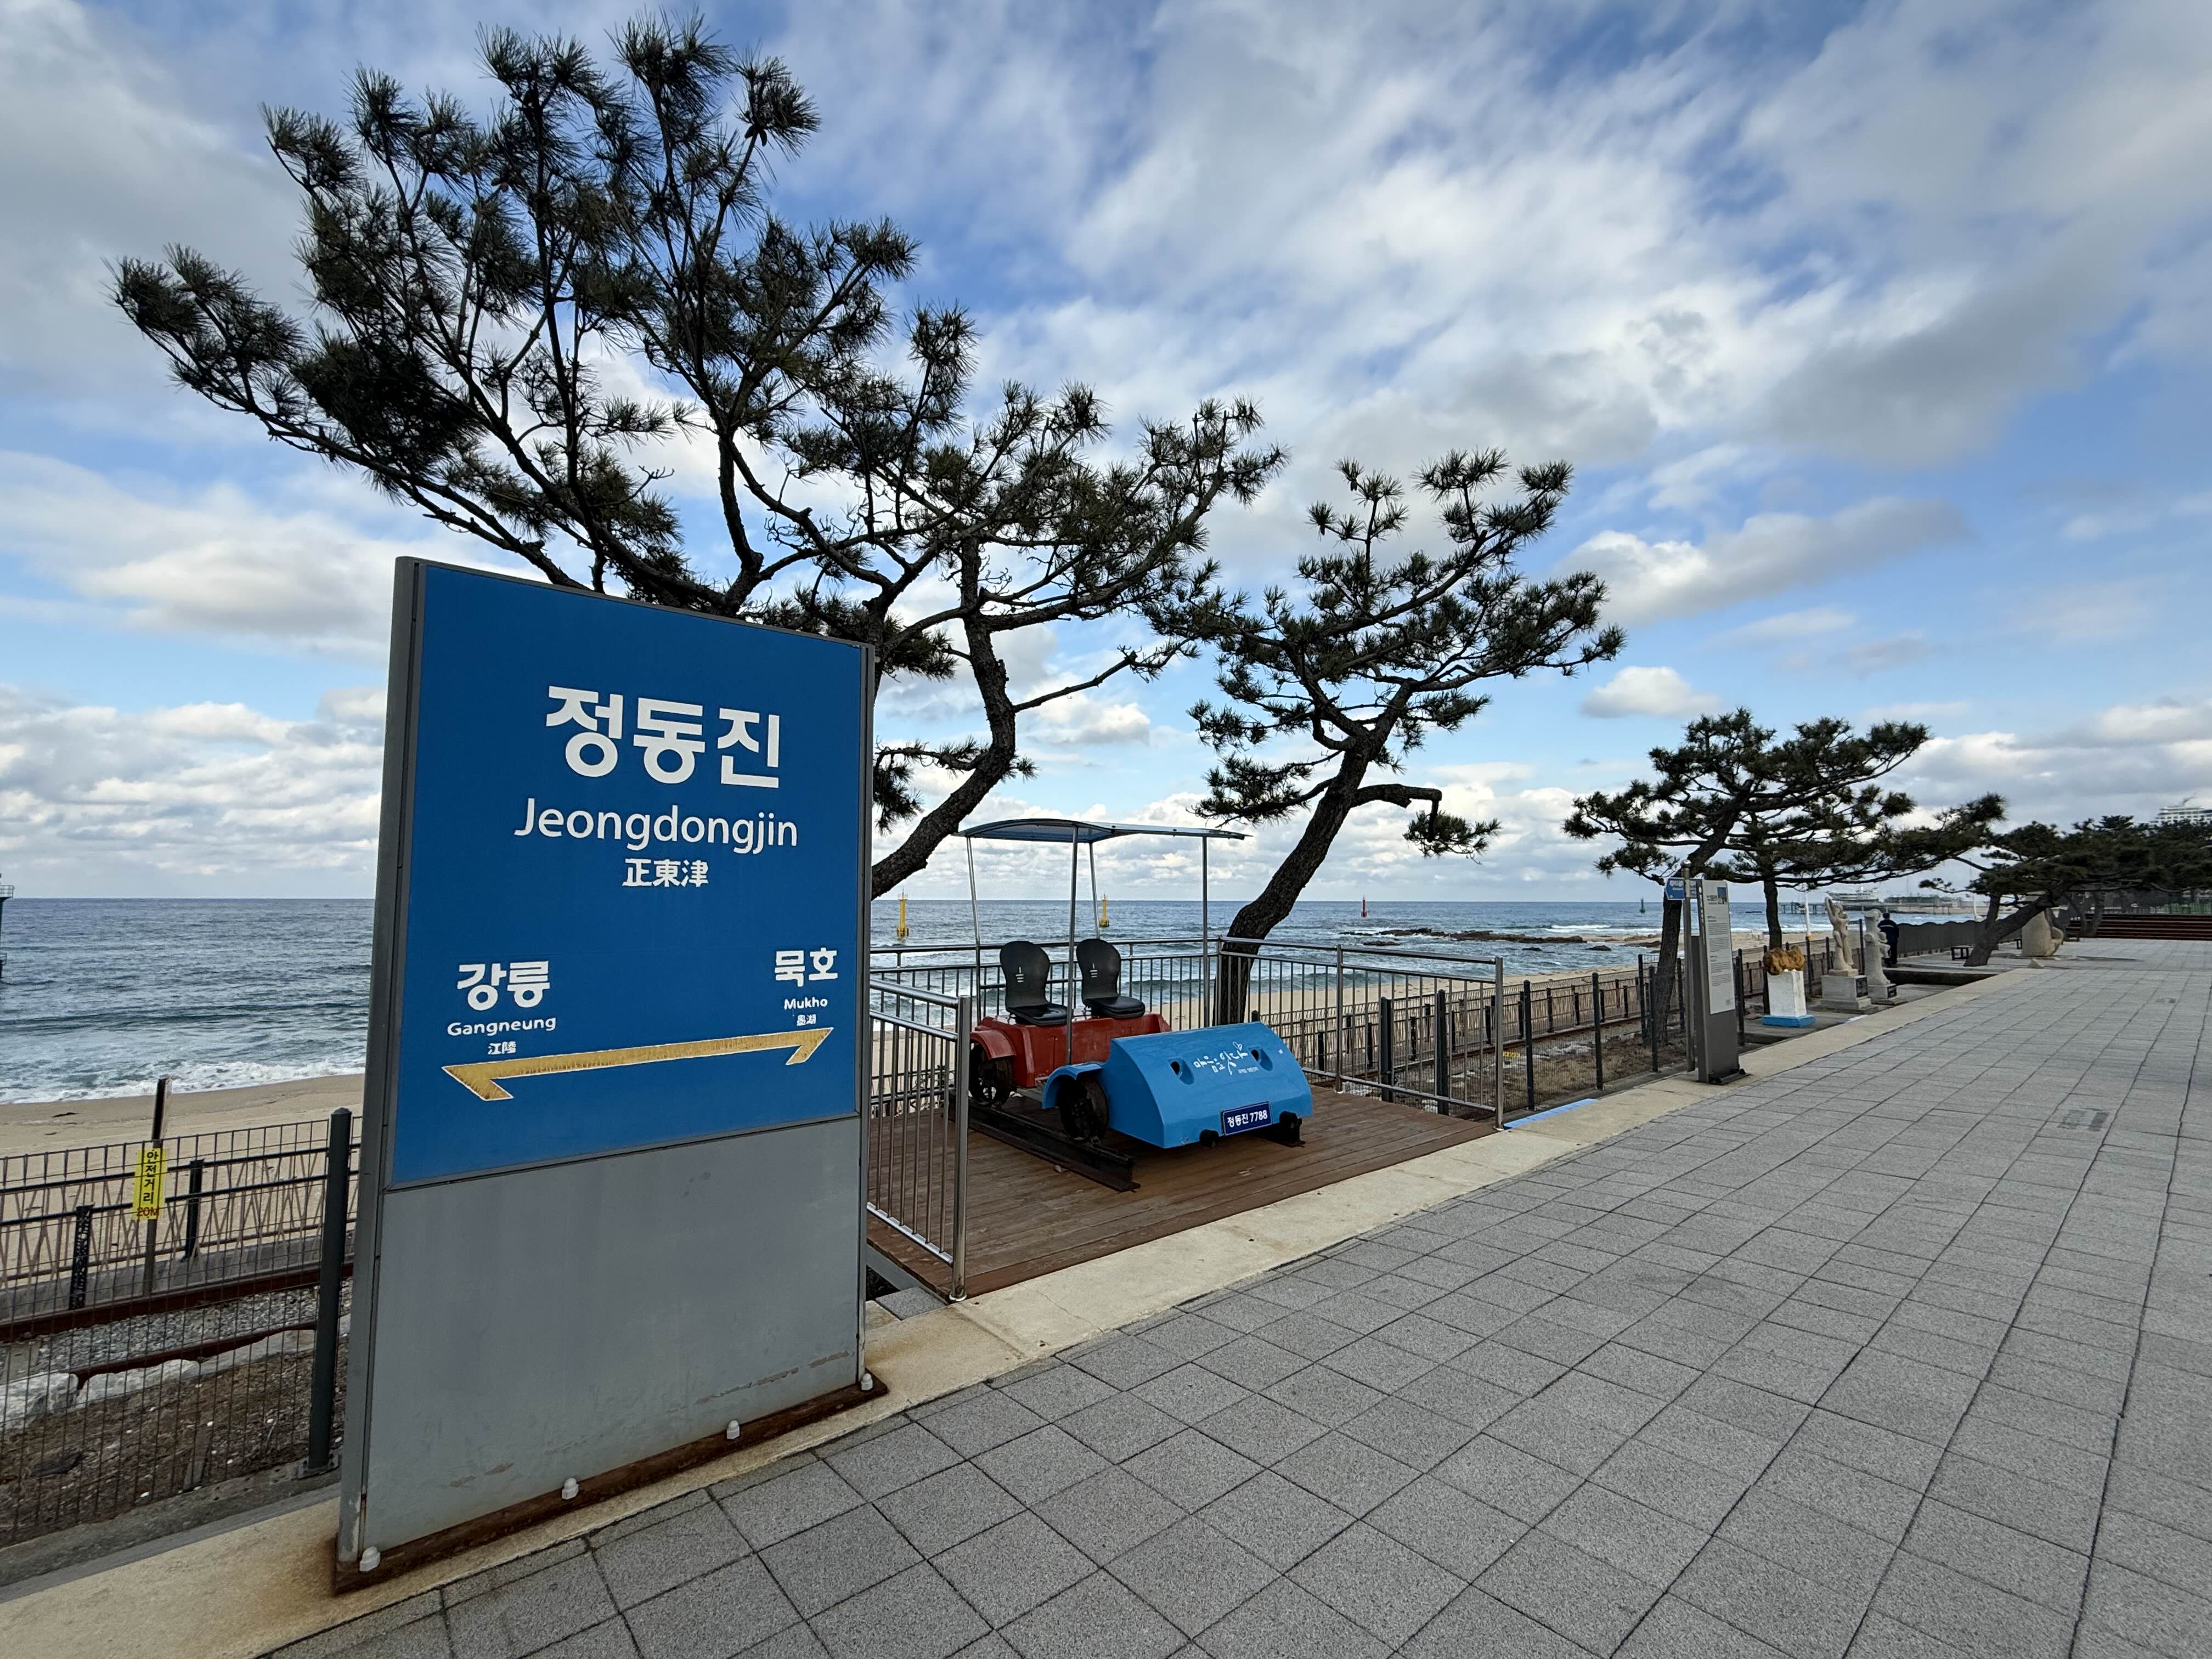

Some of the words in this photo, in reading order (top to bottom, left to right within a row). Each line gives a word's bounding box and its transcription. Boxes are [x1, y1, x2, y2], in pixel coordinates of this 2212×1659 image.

[546, 686, 780, 789] 정동진
[514, 798, 798, 855] Jeongdongjin
[622, 858, 709, 887] 正東津
[456, 961, 550, 1011] 강릉
[774, 947, 838, 987] 묵호
[783, 996, 828, 1010] Mukho
[447, 1017, 556, 1036] Gangneung
[1227, 1113, 1249, 1128] 정동진
[1249, 1109, 1268, 1123] 7788
[143, 1151, 159, 1204] 안전거리
